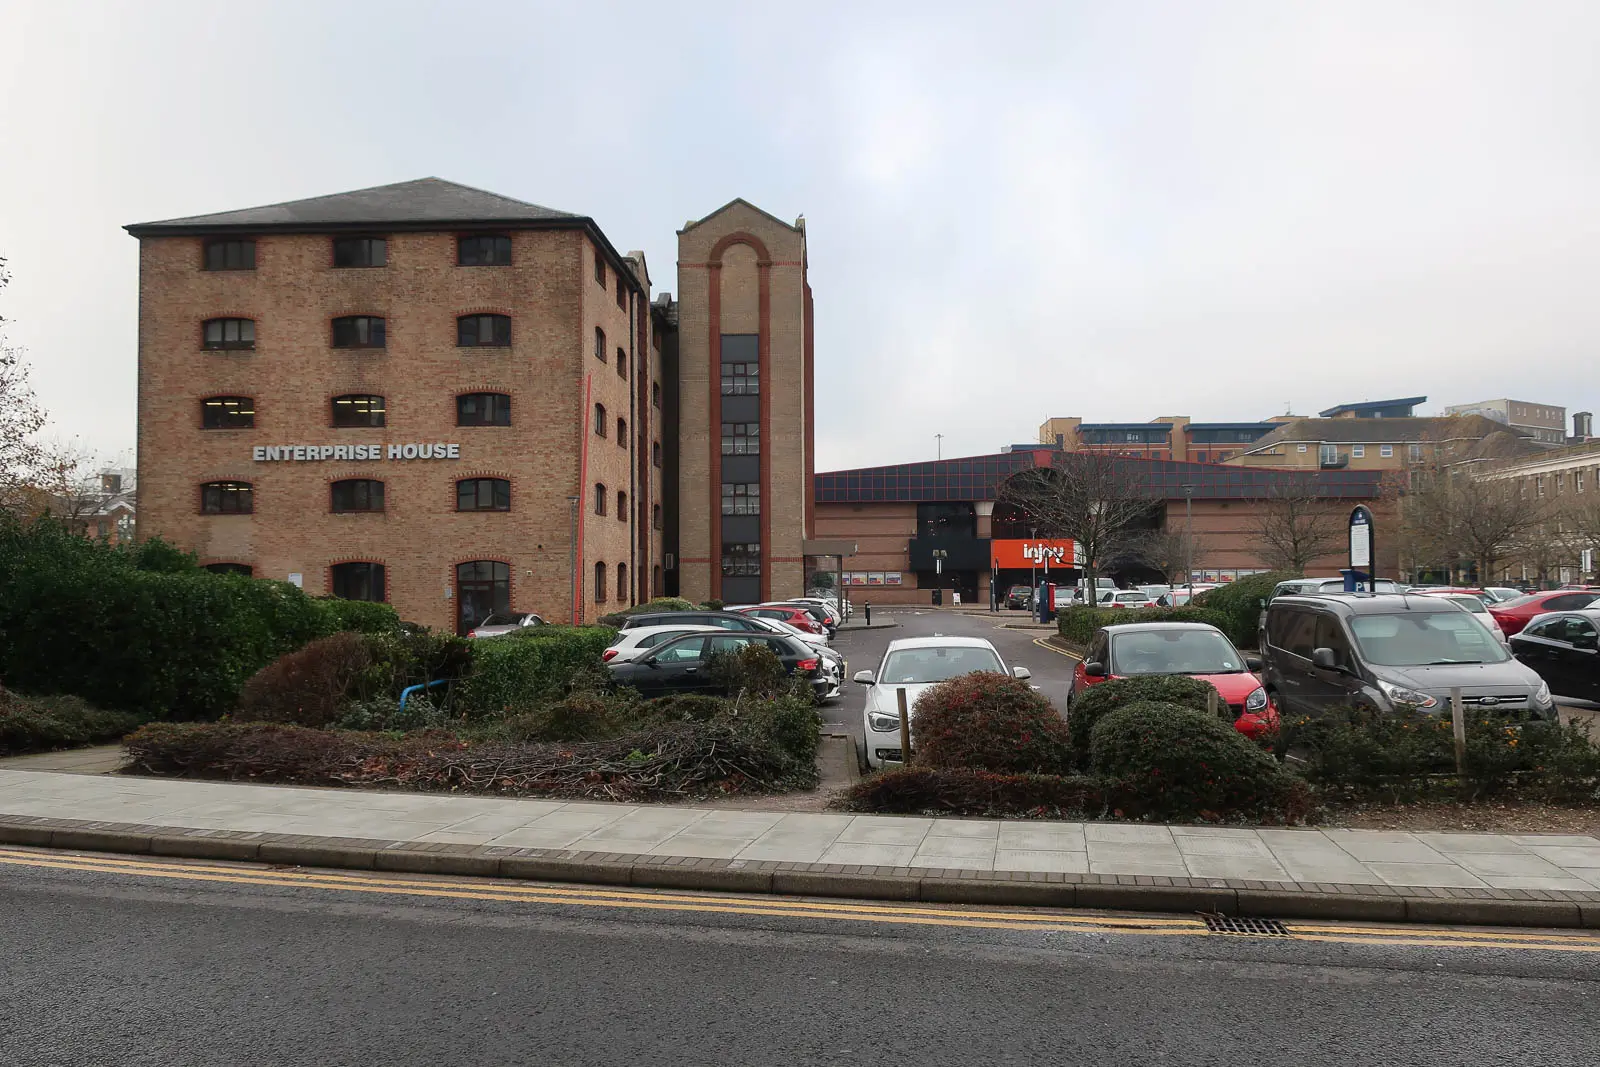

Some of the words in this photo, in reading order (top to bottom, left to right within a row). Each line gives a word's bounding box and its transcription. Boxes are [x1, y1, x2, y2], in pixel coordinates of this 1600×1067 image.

[252, 445, 381, 461] ENTERPRISE
[387, 443, 460, 459] HOUSE
[1023, 543, 1065, 564] injoy
[1355, 582, 1363, 592] P
